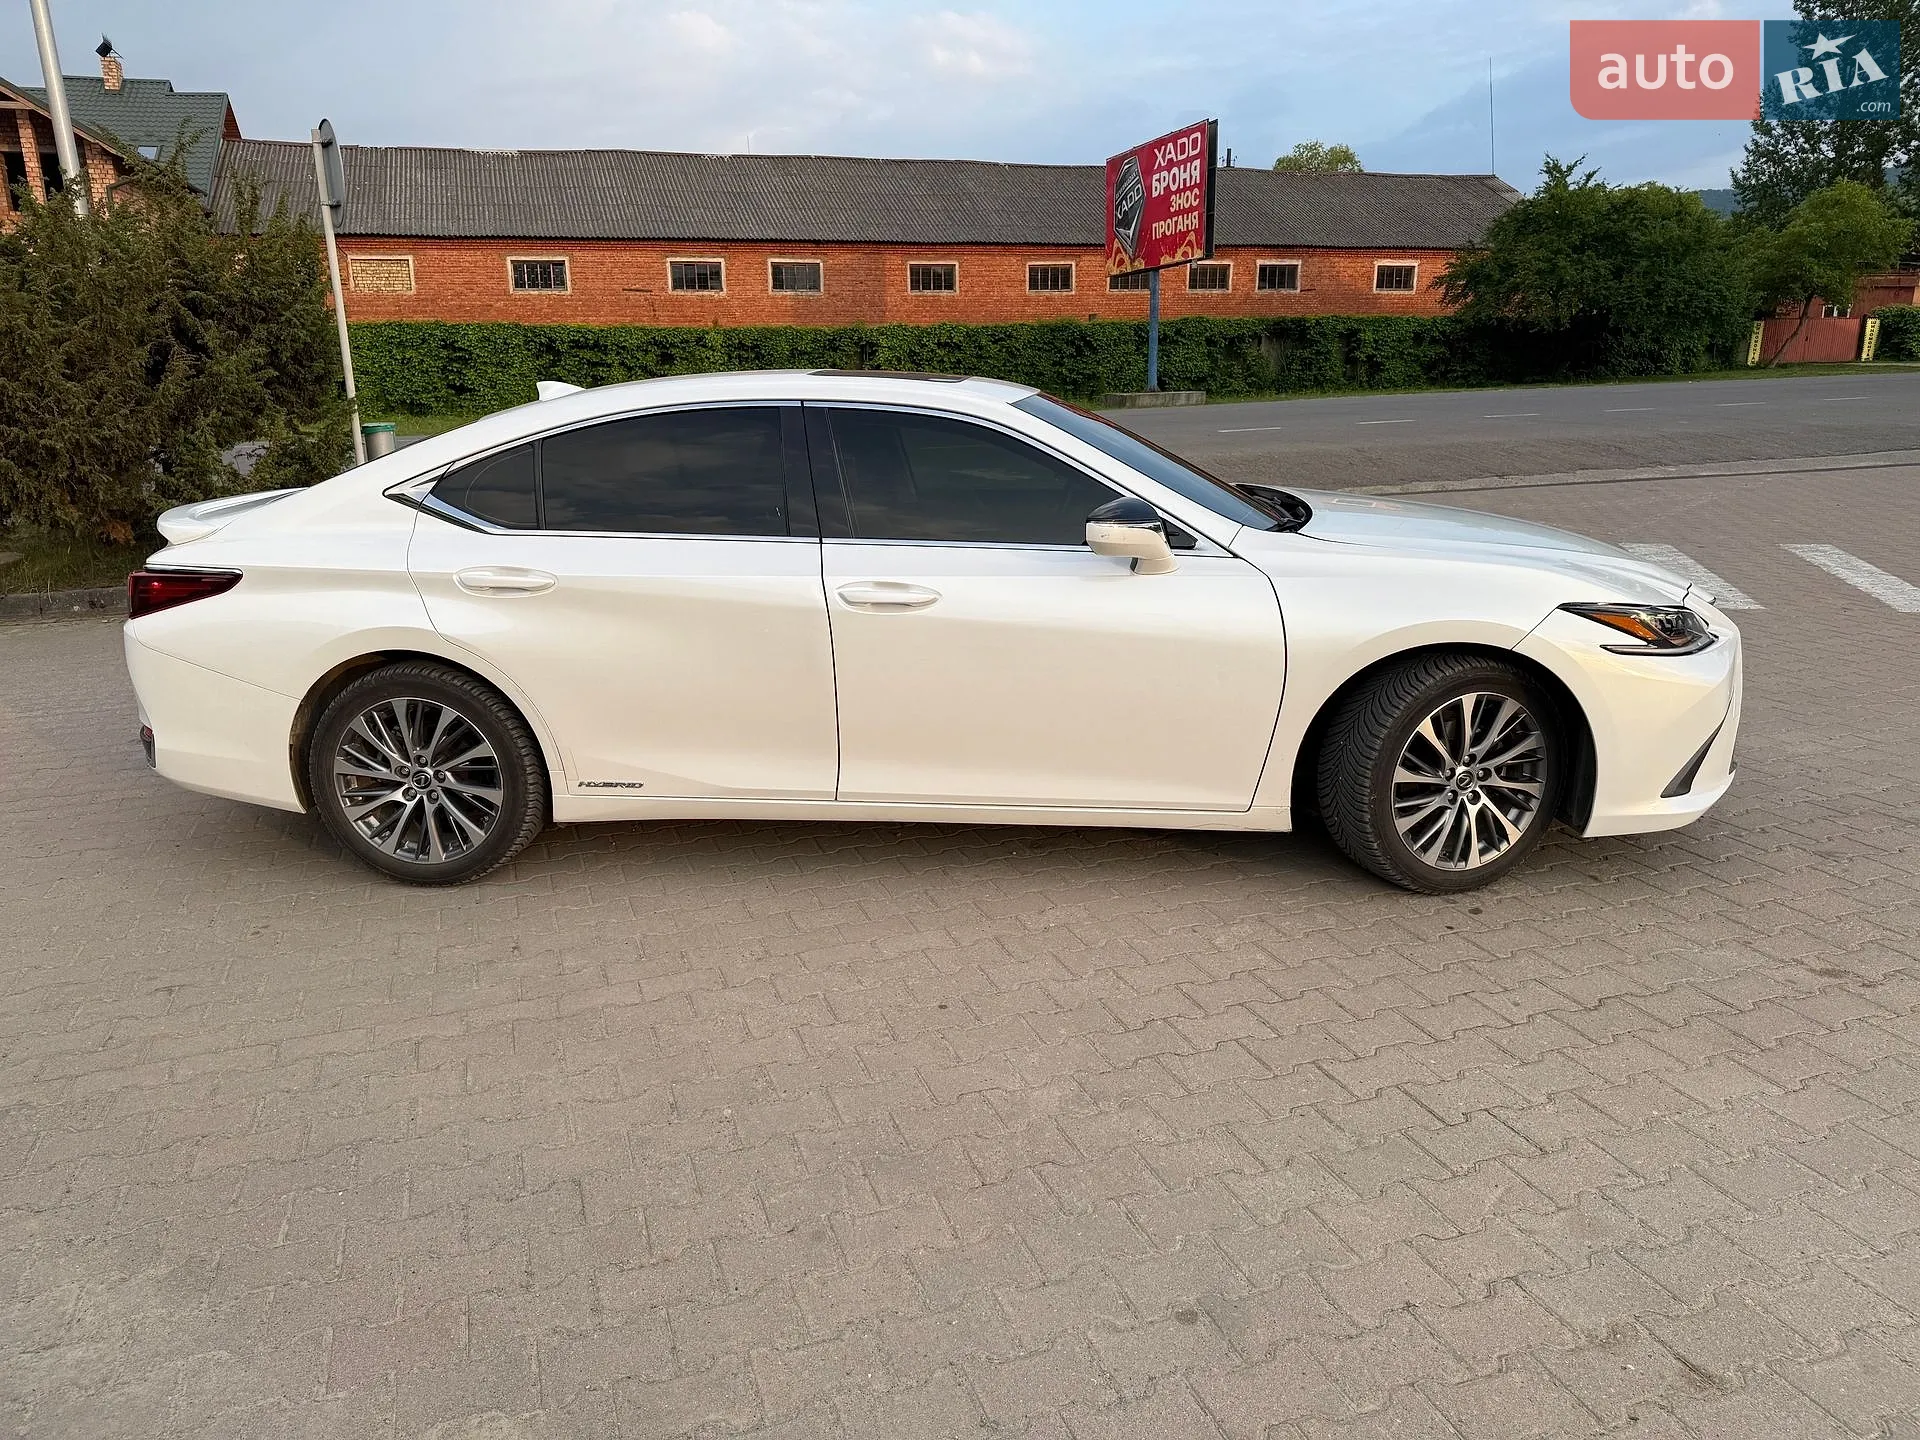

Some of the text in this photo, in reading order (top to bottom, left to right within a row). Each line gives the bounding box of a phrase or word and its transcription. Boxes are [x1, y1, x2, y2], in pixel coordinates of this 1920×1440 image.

[1152, 158, 1200, 198] БРОНЯ
[1170, 188, 1200, 213] ЗНОС
[1152, 211, 1199, 240] ПРОГАНЯ
